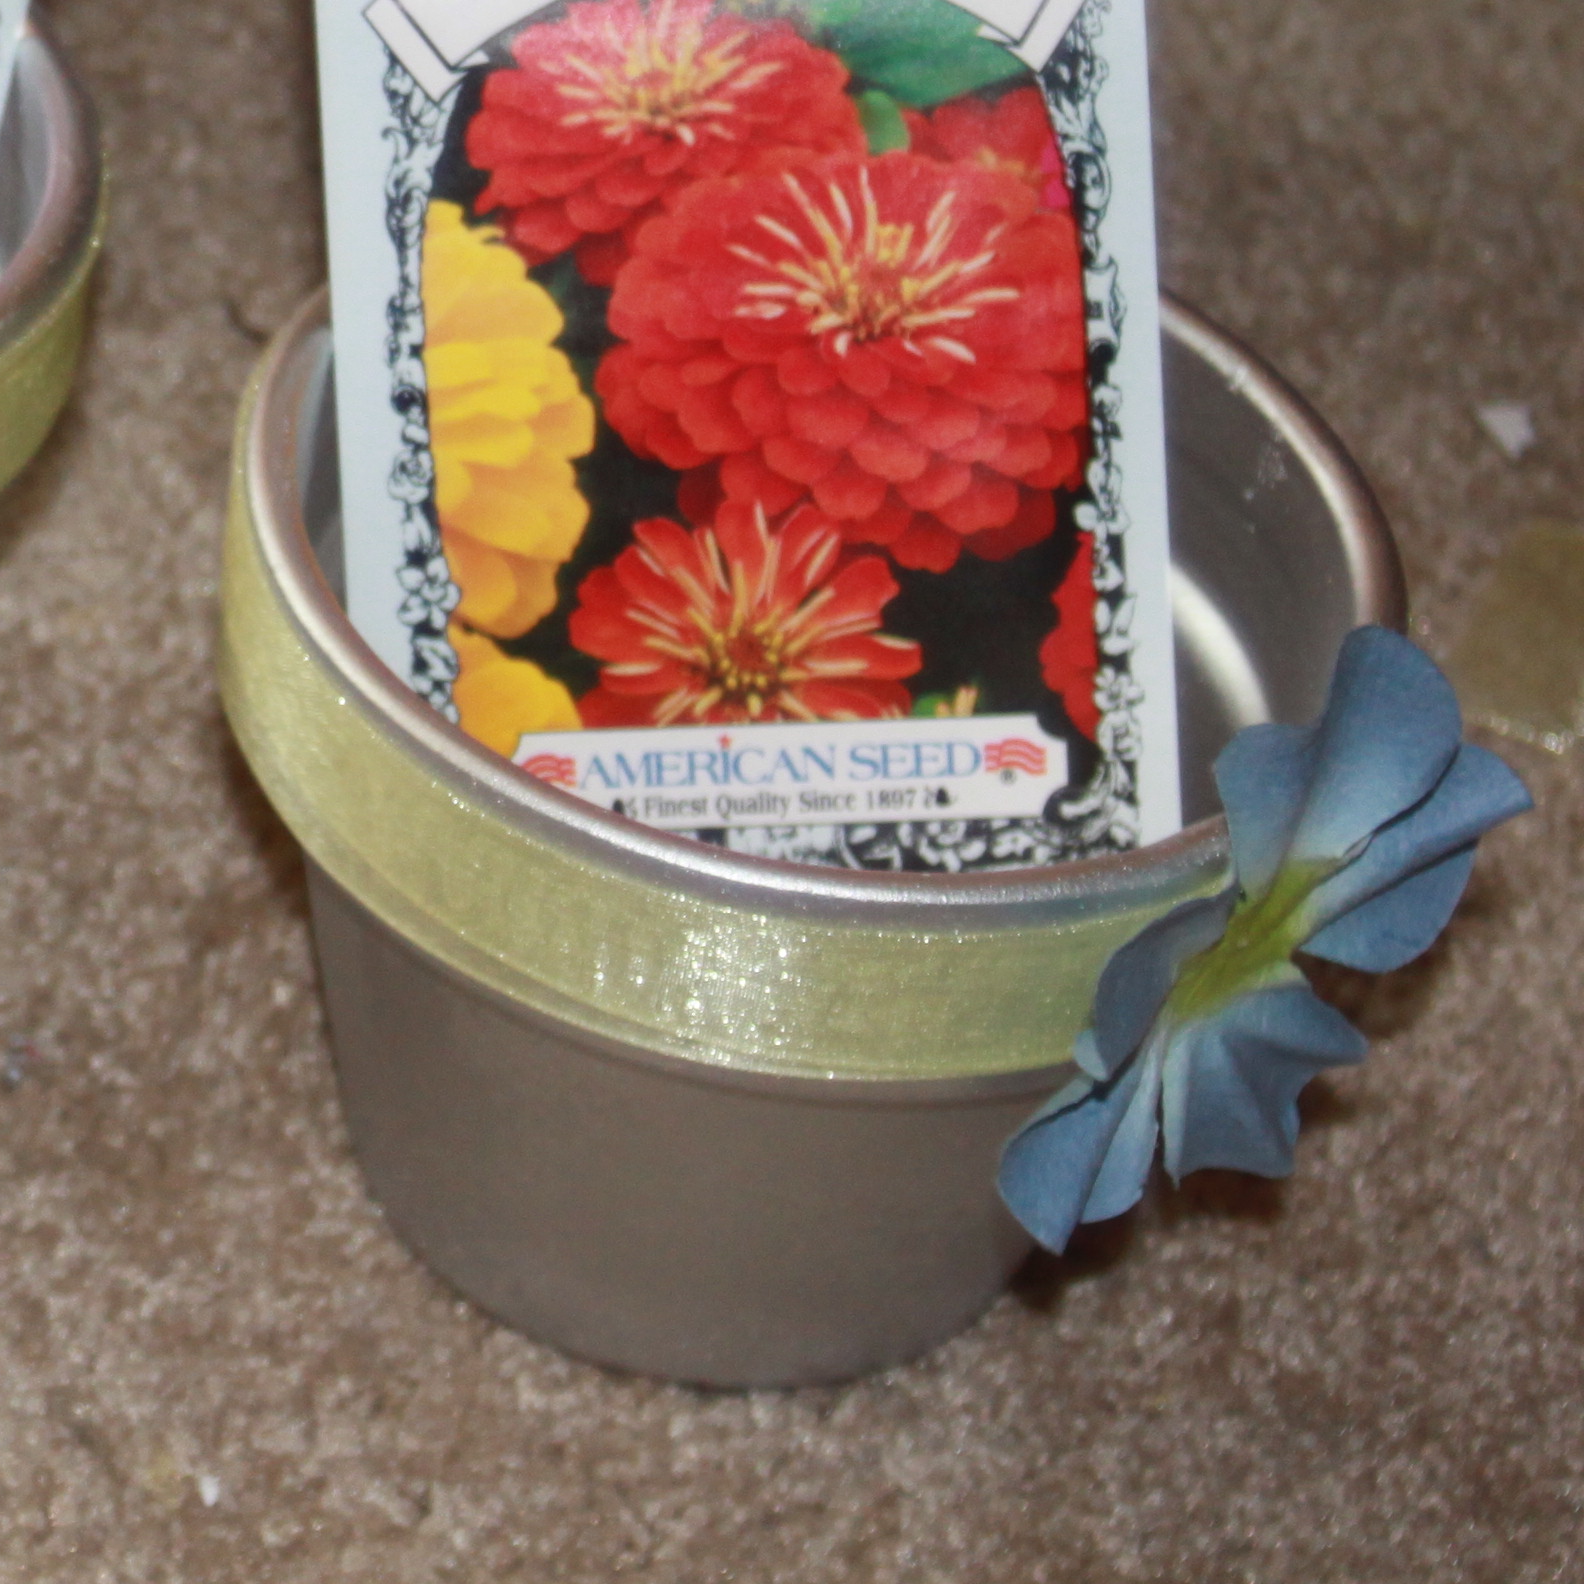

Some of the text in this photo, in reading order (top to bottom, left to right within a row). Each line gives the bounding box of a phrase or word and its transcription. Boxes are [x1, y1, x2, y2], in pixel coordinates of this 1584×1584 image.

[579, 737, 982, 790] AMERICAN SEED
[643, 787, 918, 820] Finest Quality Since 1897
